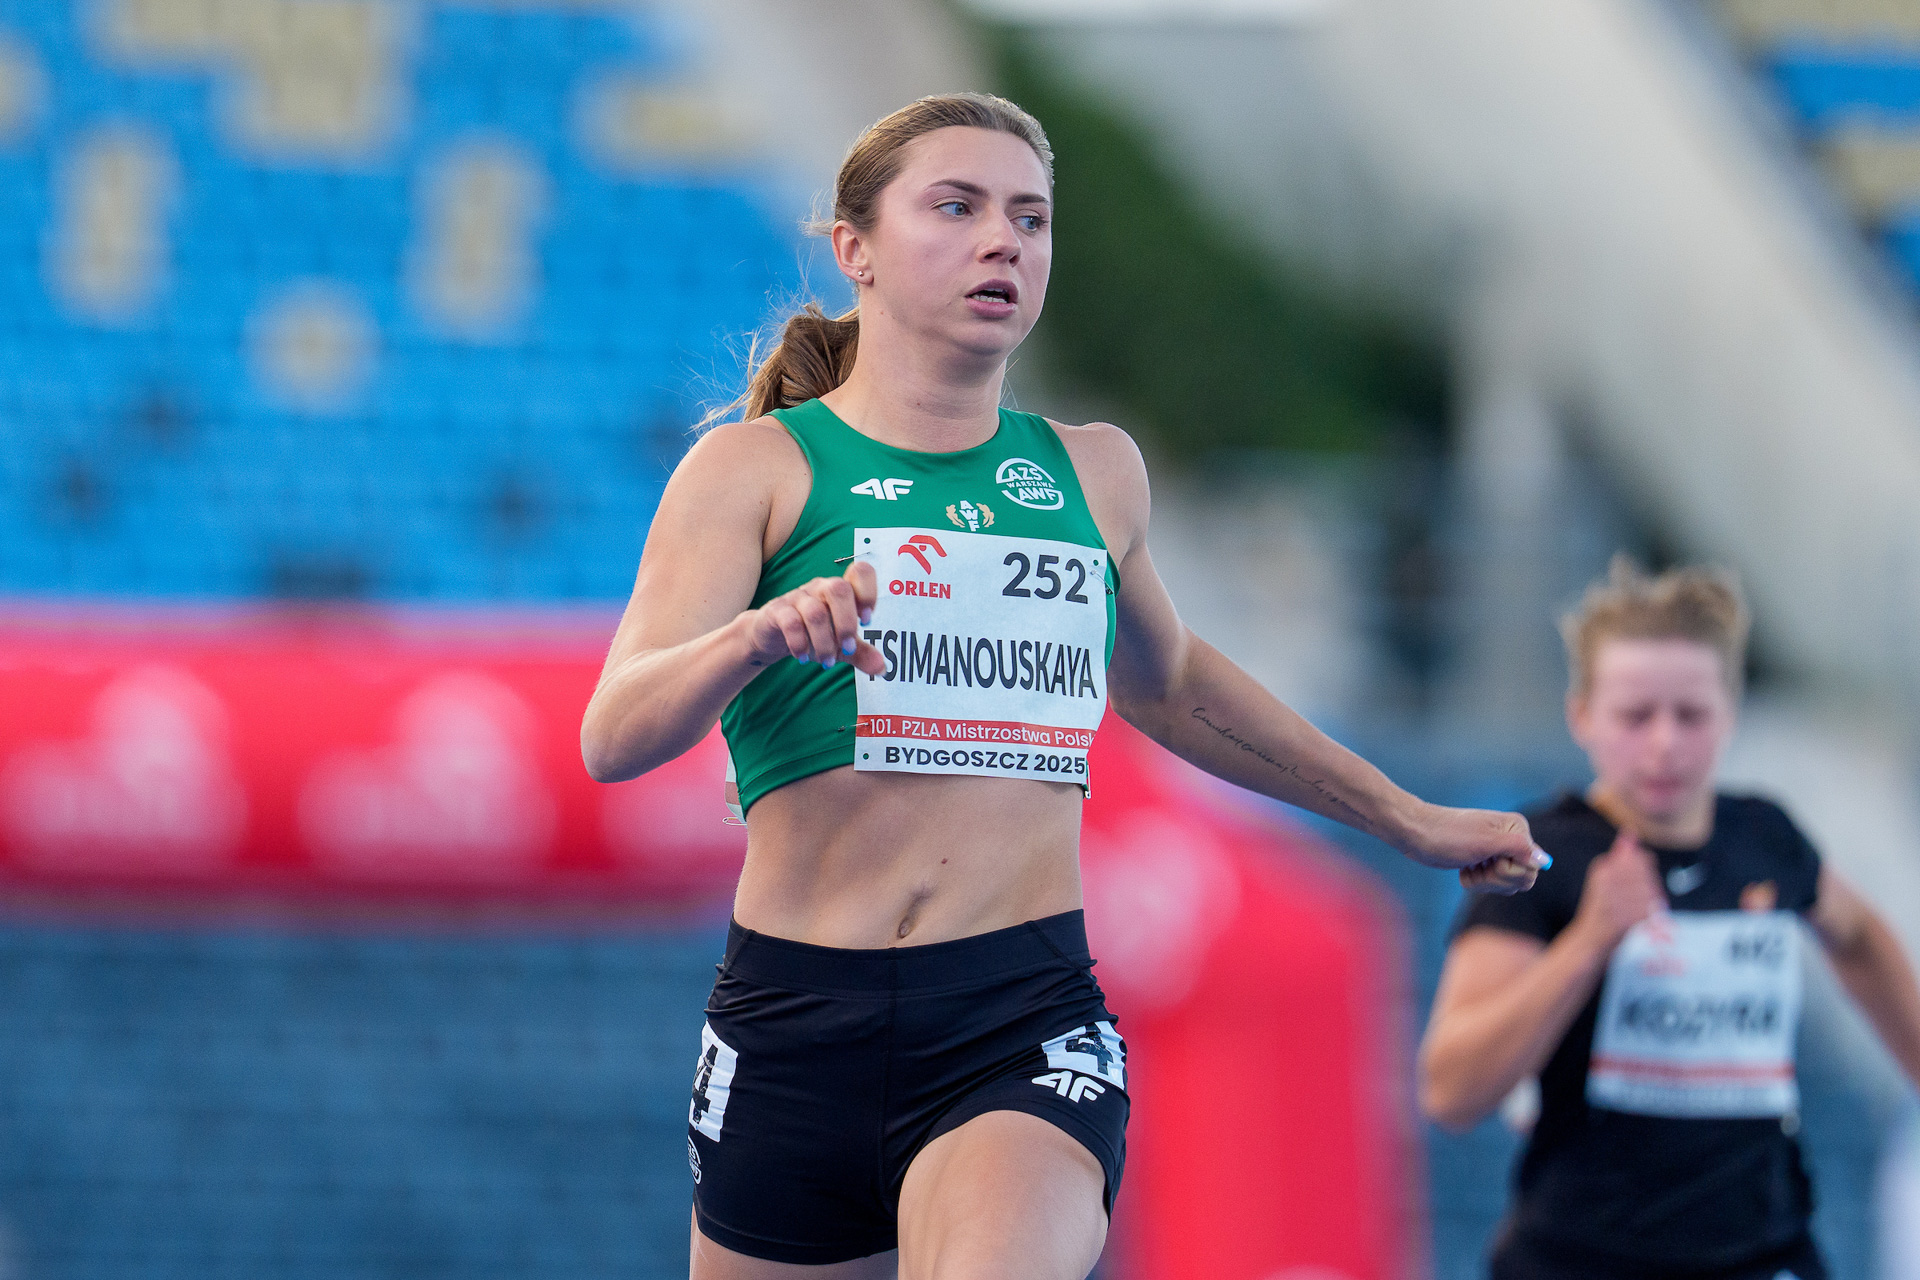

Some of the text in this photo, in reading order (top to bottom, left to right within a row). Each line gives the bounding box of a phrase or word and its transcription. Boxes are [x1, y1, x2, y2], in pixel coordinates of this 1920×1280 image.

[1006, 480, 1054, 489] WARSZAWA
[1007, 467, 1043, 481] AZS
[850, 478, 914, 501] 4F
[1019, 487, 1057, 501] AWF
[959, 500, 980, 532] AWF
[889, 579, 951, 600] ORLEN
[1002, 552, 1089, 604] 252
[863, 630, 1098, 699] TSIMANOUSKAYA
[870, 718, 897, 735] 101.
[902, 720, 941, 738] PZLA
[946, 723, 1051, 745] Mistrzostwa
[885, 746, 1086, 775] BYDGOSZCZ 2025
[1064, 1022, 1114, 1076] 4
[692, 1043, 719, 1125] 4
[1031, 1070, 1106, 1103] 4F
